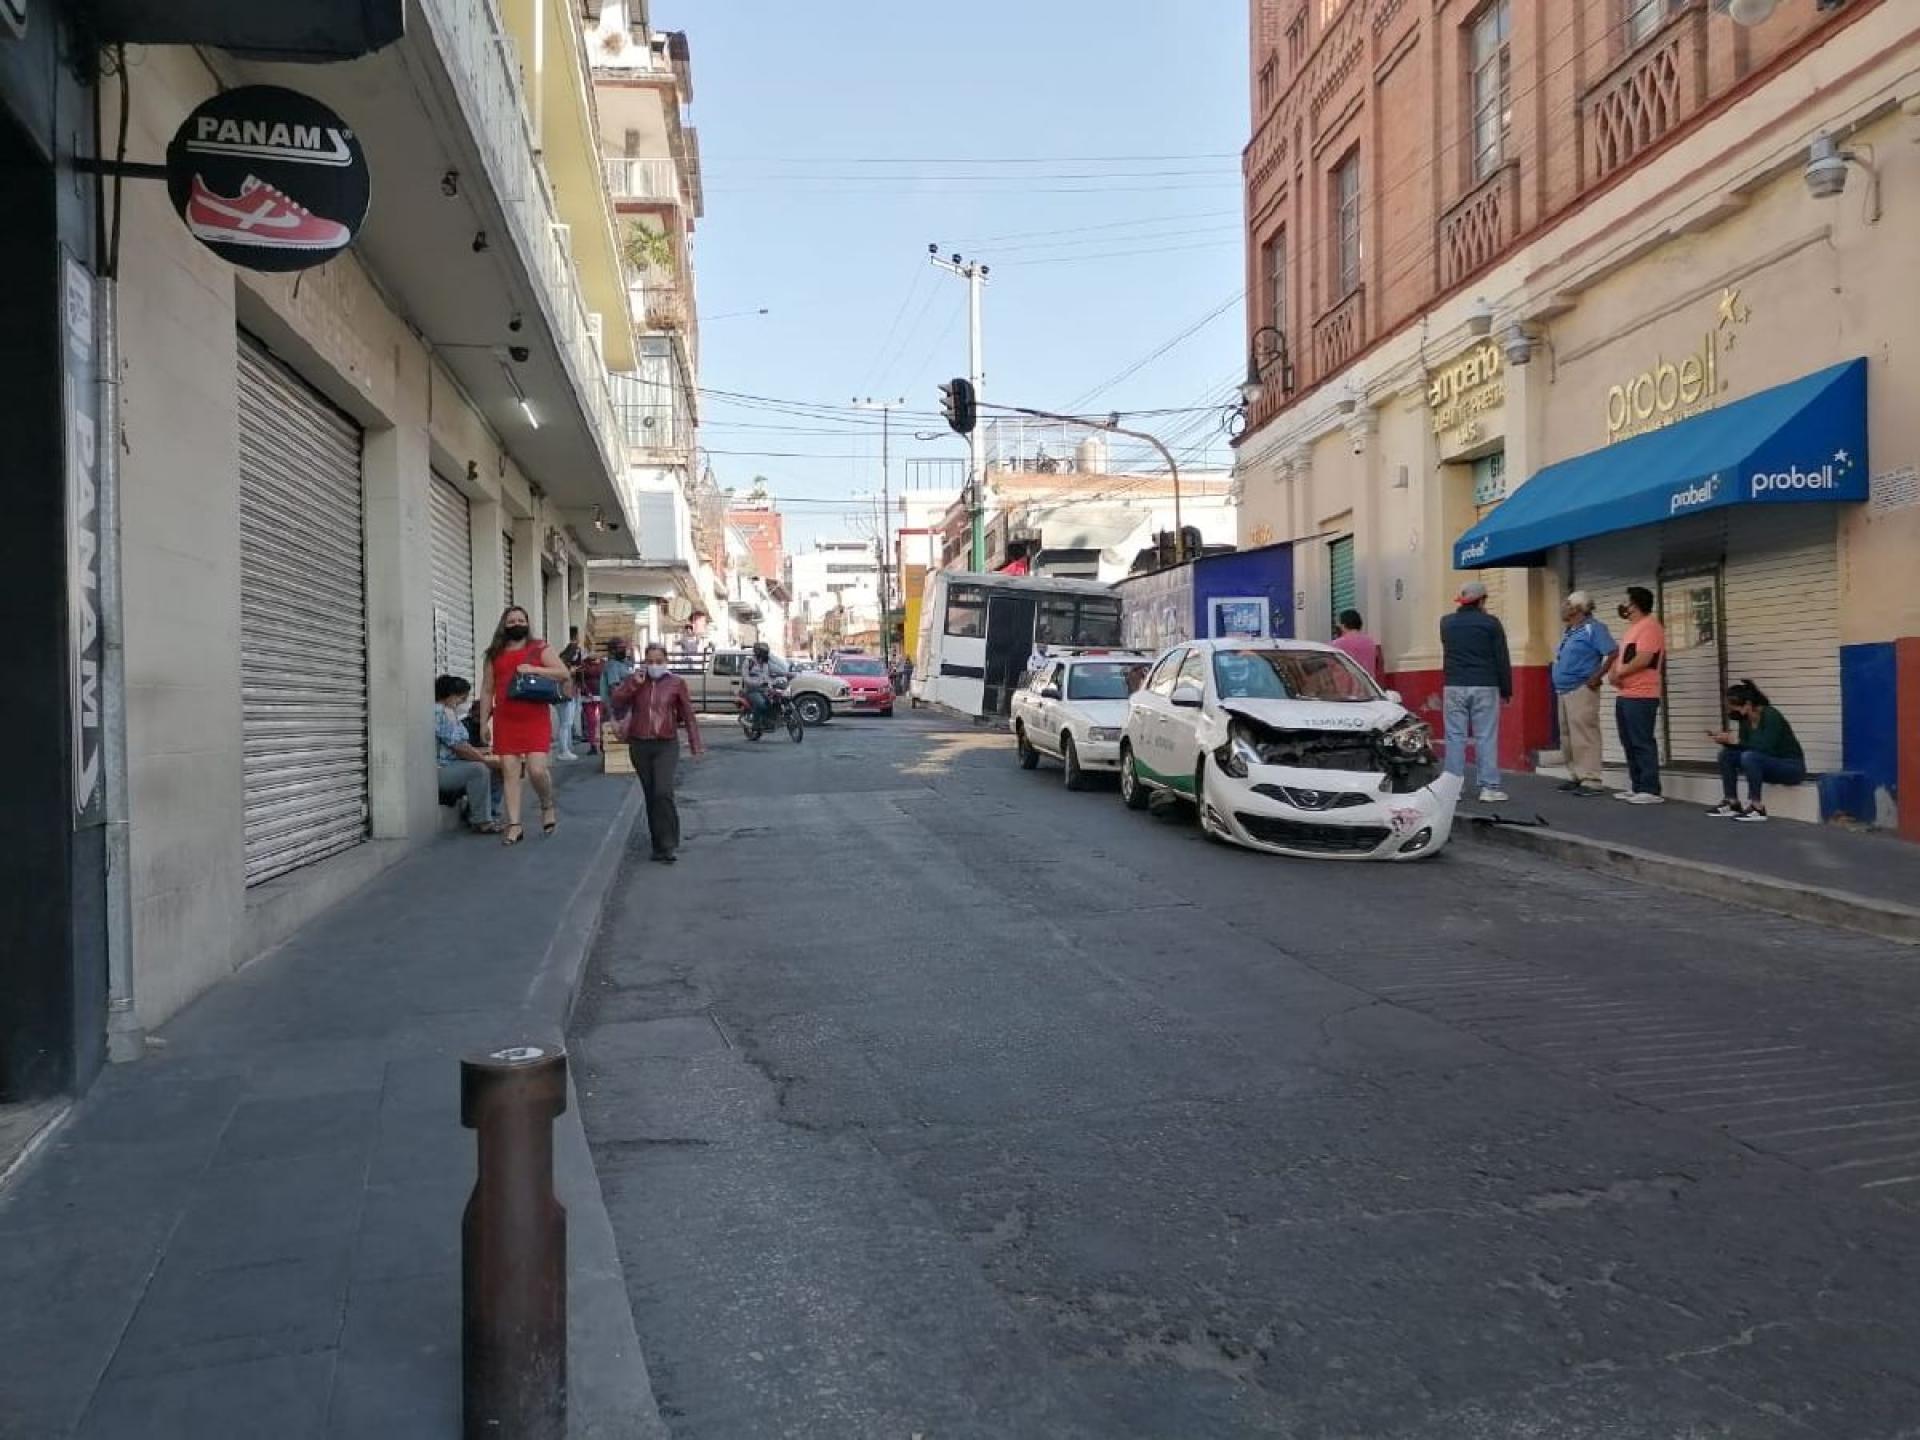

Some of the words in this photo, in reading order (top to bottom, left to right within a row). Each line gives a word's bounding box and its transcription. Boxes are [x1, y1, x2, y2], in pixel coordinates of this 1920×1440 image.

[1428, 346, 1499, 407] empeño
[1606, 329, 1717, 445] probell
[1671, 480, 1711, 514] probell
[1751, 464, 1833, 498] probell
